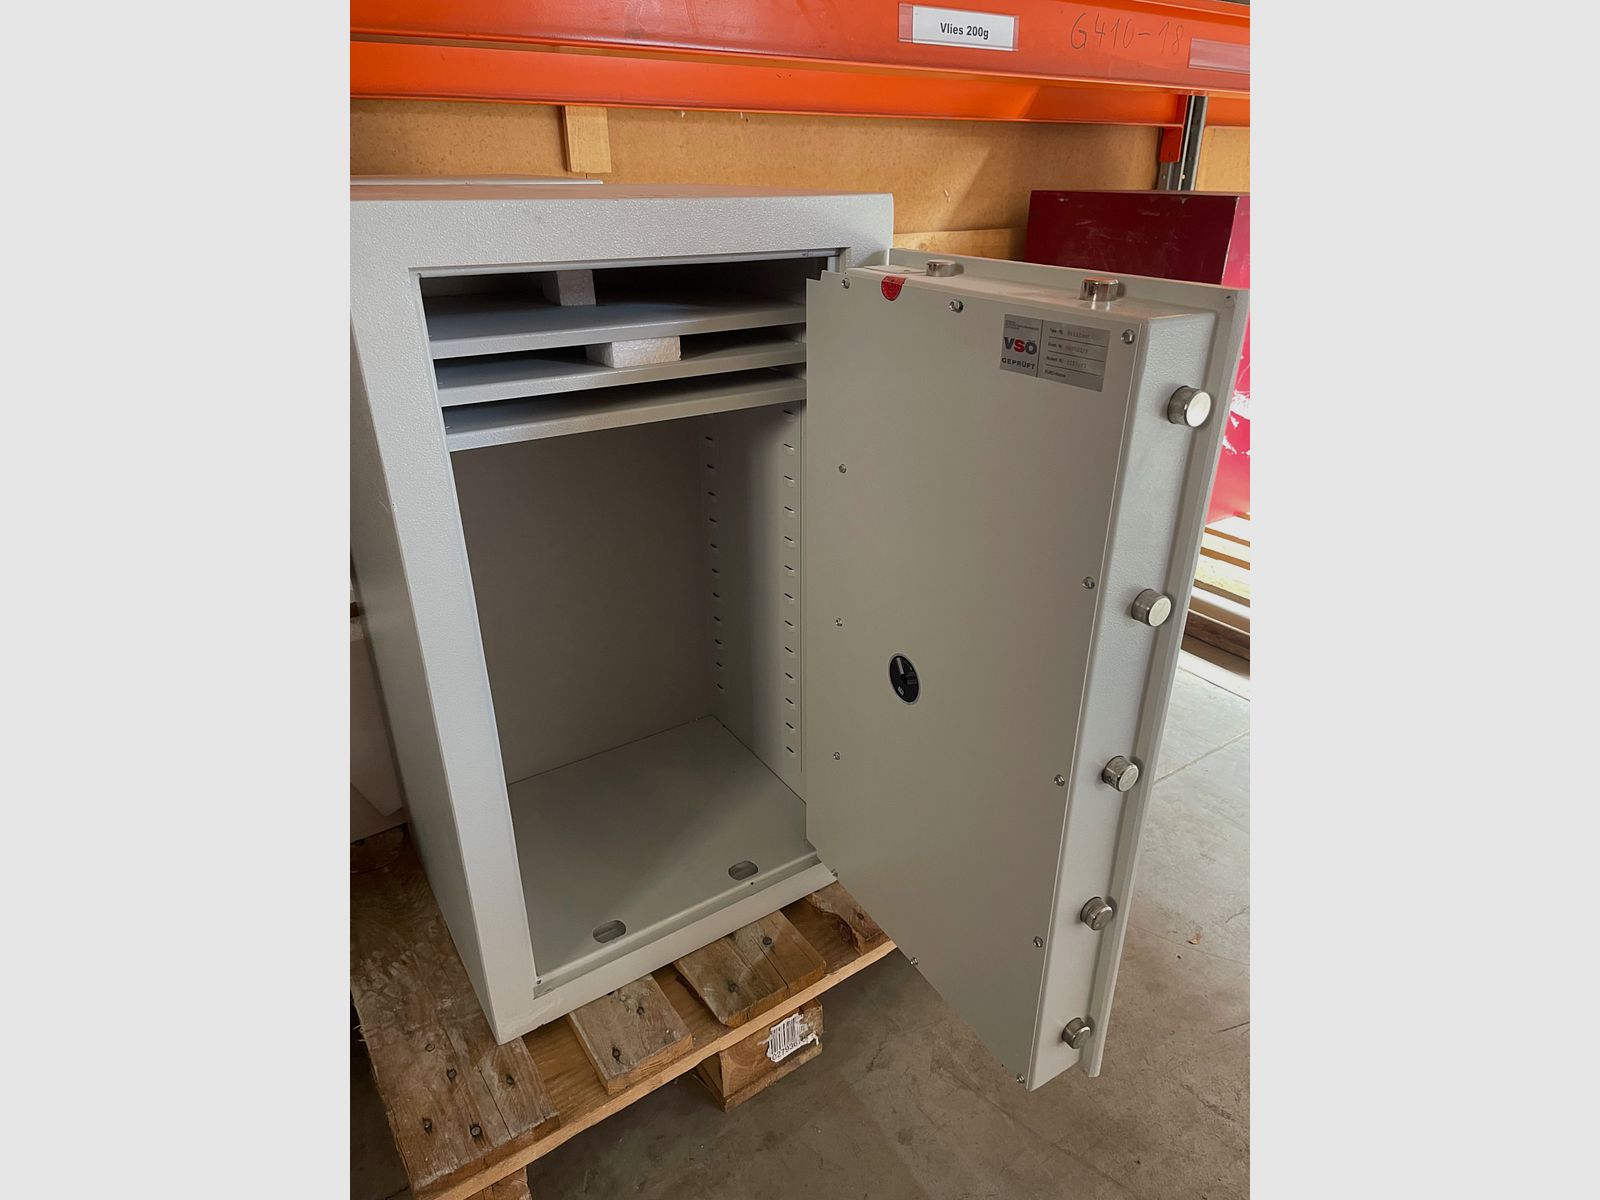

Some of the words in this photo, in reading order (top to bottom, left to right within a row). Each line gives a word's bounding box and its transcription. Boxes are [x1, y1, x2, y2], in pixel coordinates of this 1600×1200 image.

[940, 22, 964, 35] Vlies
[966, 25, 989, 40] 200g
[1003, 336, 1038, 355] VSÖ
[1001, 357, 1036, 370] GEPRÜFT
